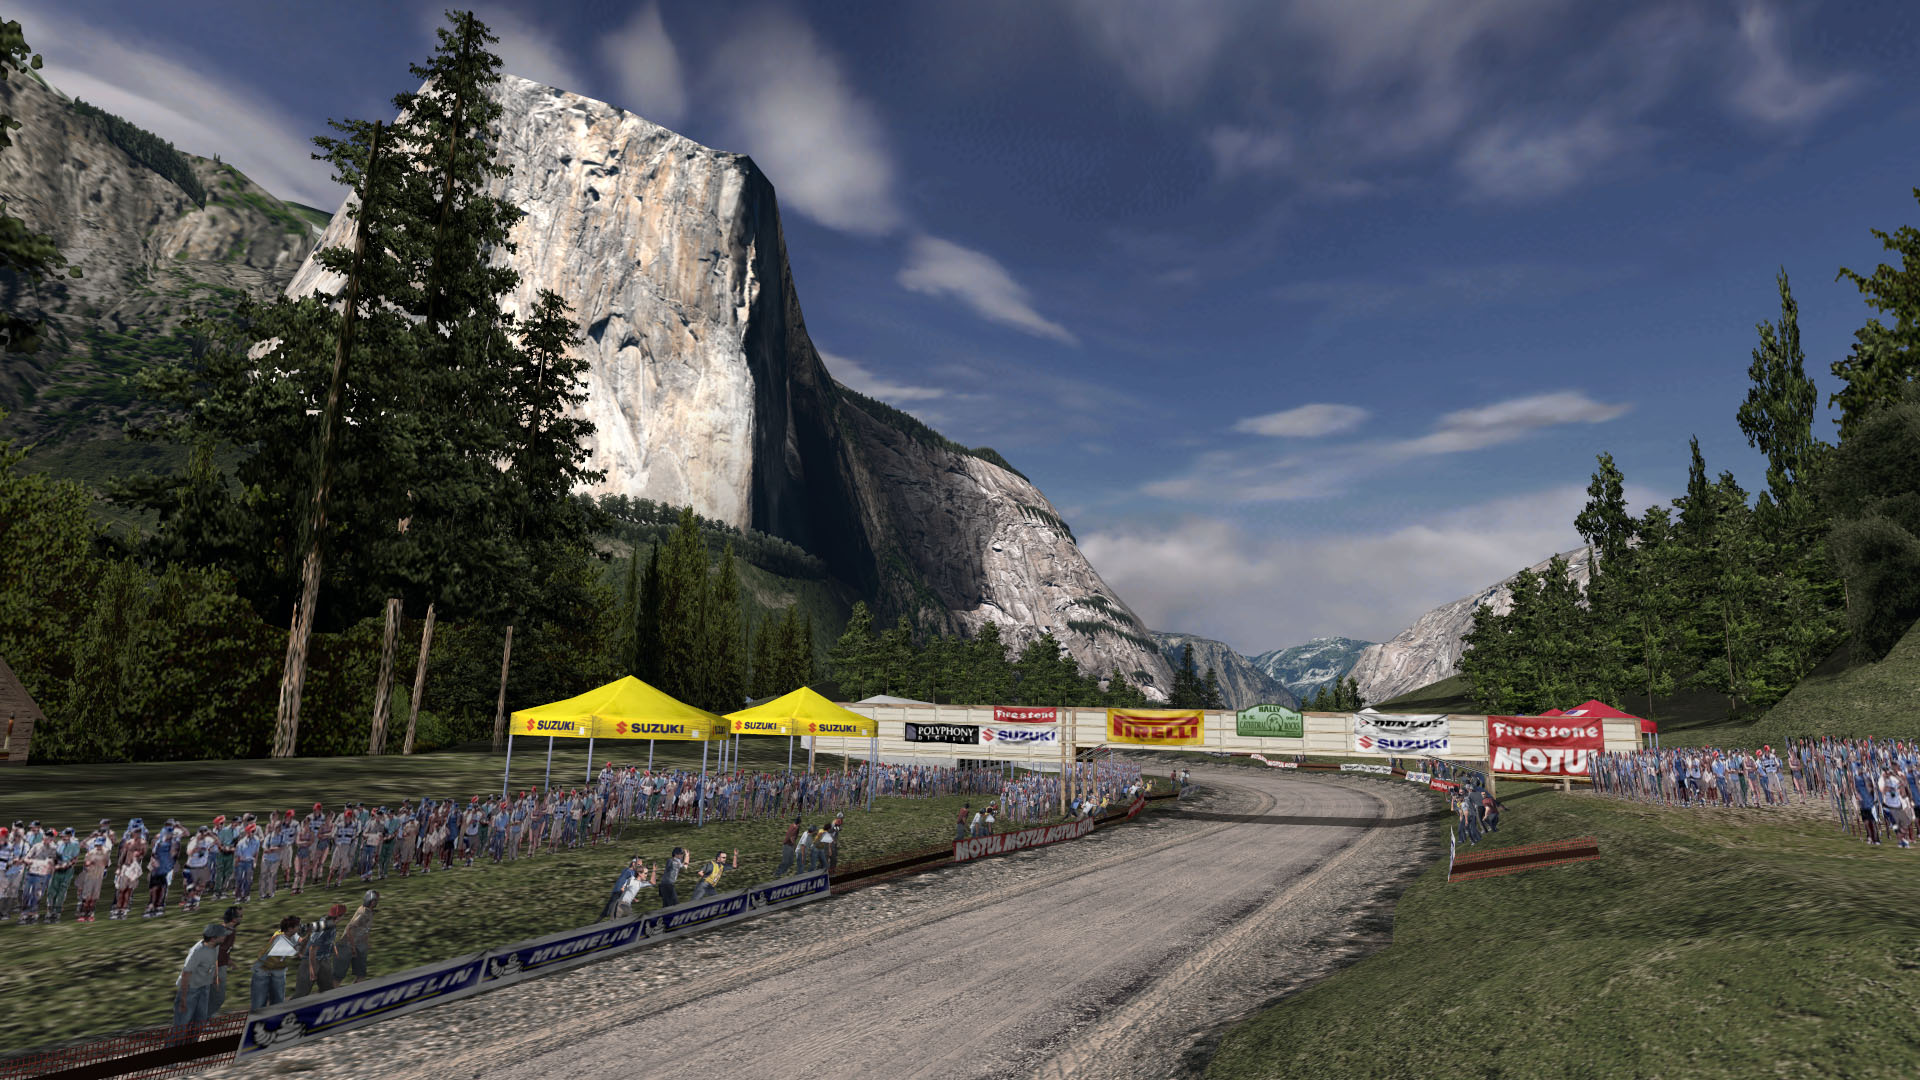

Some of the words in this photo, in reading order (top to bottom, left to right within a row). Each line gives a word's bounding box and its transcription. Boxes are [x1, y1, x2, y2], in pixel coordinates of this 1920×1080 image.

[995, 709, 1055, 719] Firestone
[536, 720, 575, 731] SUZUKI
[631, 723, 684, 734] SUZUKI
[744, 721, 777, 731] SUZUKI
[818, 723, 857, 733] SUZUKI
[1113, 714, 1199, 739] PIRELLI
[1372, 719, 1444, 728] DUNLOP
[917, 726, 974, 737] POLYPHONY
[997, 730, 1056, 741] SUZUKI
[1492, 722, 1599, 738] Firestone
[1377, 738, 1448, 749] SUZUKI
[955, 836, 1002, 861] MOTUL
[1003, 828, 1047, 852] MOTUL
[1046, 822, 1077, 843] MOTUL
[770, 877, 826, 900] MICHELIN
[669, 898, 744, 927] MICHELIN
[528, 926, 634, 965] MICHELIN
[314, 967, 473, 1026] MICHELIN
